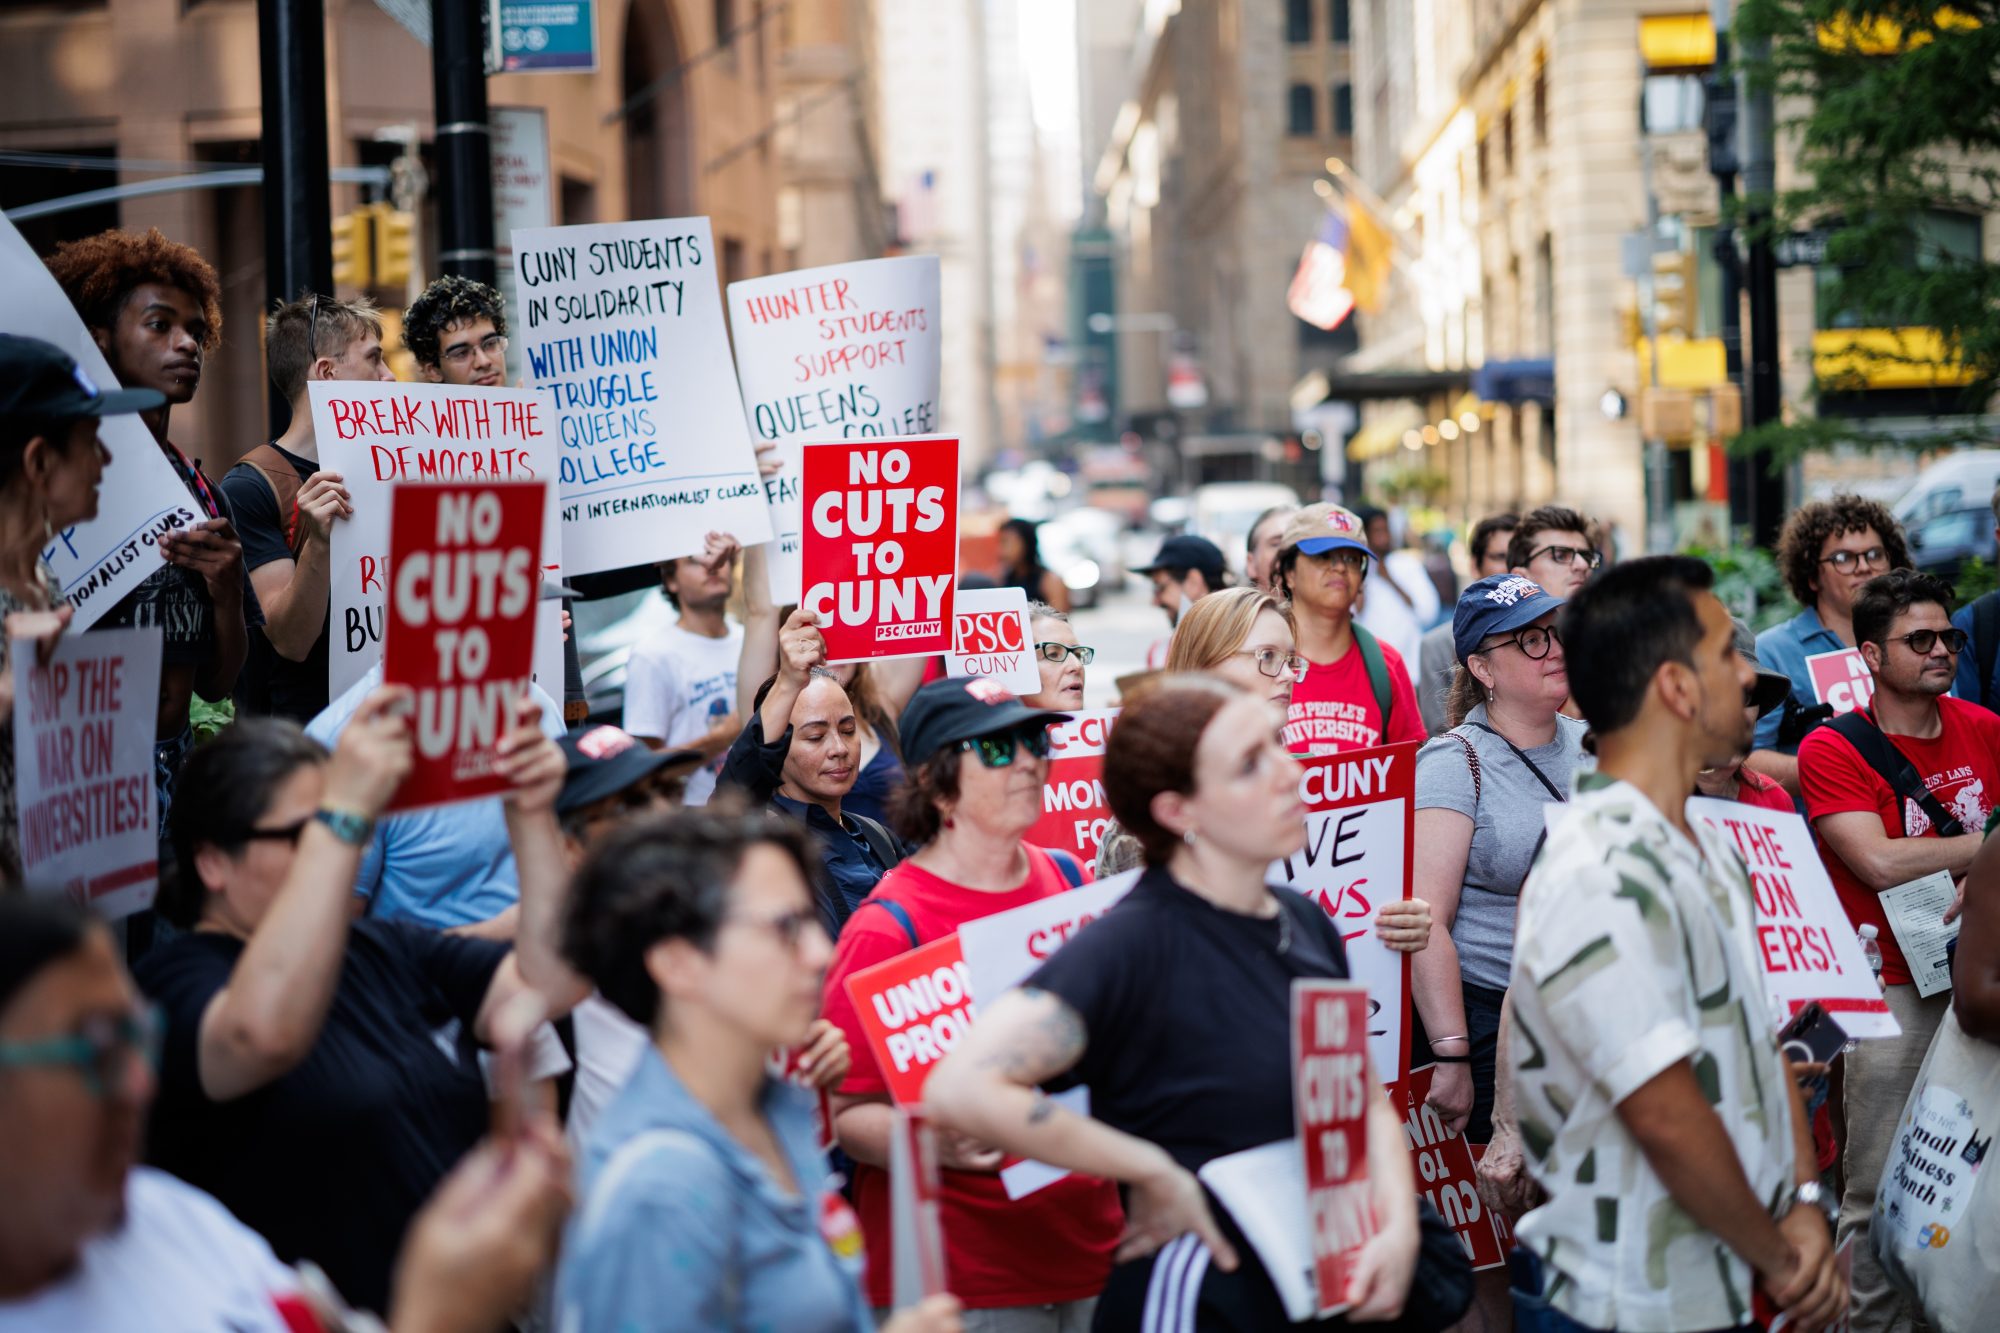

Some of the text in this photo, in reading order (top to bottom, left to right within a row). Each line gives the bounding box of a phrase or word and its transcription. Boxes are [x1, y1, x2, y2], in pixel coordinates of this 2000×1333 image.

[520, 235, 702, 288] CUNY STUDENTS
[529, 280, 684, 328] IN SOLIDARITY
[746, 278, 859, 325] HUNTER
[818, 308, 928, 341] STUDENTS
[527, 325, 658, 380] WITH UNION
[794, 339, 907, 383] SUPPORT
[328, 395, 543, 441] BREAK WITH THE
[560, 408, 657, 450] QUEENS
[755, 384, 880, 440] QUEENS
[370, 444, 536, 483] DEMOCRATS
[559, 441, 666, 485] OLLEGE
[849, 448, 911, 485] NO
[435, 490, 503, 547] NO
[562, 503, 579, 522] NY
[588, 488, 711, 520] INTERNATIONALIST
[717, 483, 759, 500] CLUBS
[811, 485, 946, 538] CUTS
[66, 540, 142, 612] TIONALIST
[852, 540, 905, 576] TO
[394, 546, 531, 628] CUTS
[802, 573, 953, 630] CUNY
[434, 626, 491, 682] TO
[876, 622, 942, 640] PSC/CUNY
[955, 611, 1026, 655] PSC
[76, 656, 124, 718] THE
[964, 655, 1020, 676] CUNY
[1845, 655, 1870, 678] N
[1280, 719, 1379, 748] NIVERSITY
[1305, 701, 1366, 722] PEOPLE'S
[80, 719, 114, 780] ON
[1946, 765, 1973, 781] LAWS
[1299, 754, 1395, 805] CUNY
[1723, 819, 1792, 869] THE
[1750, 871, 1803, 919] ON
[1757, 925, 1843, 975] ERS!
[1314, 998, 1348, 1048] NO
[1301, 1052, 1364, 1125] CUTS
[1319, 1127, 1348, 1180] TO
[1912, 1118, 1957, 1157] mall
[1419, 1148, 1450, 1183] TO
